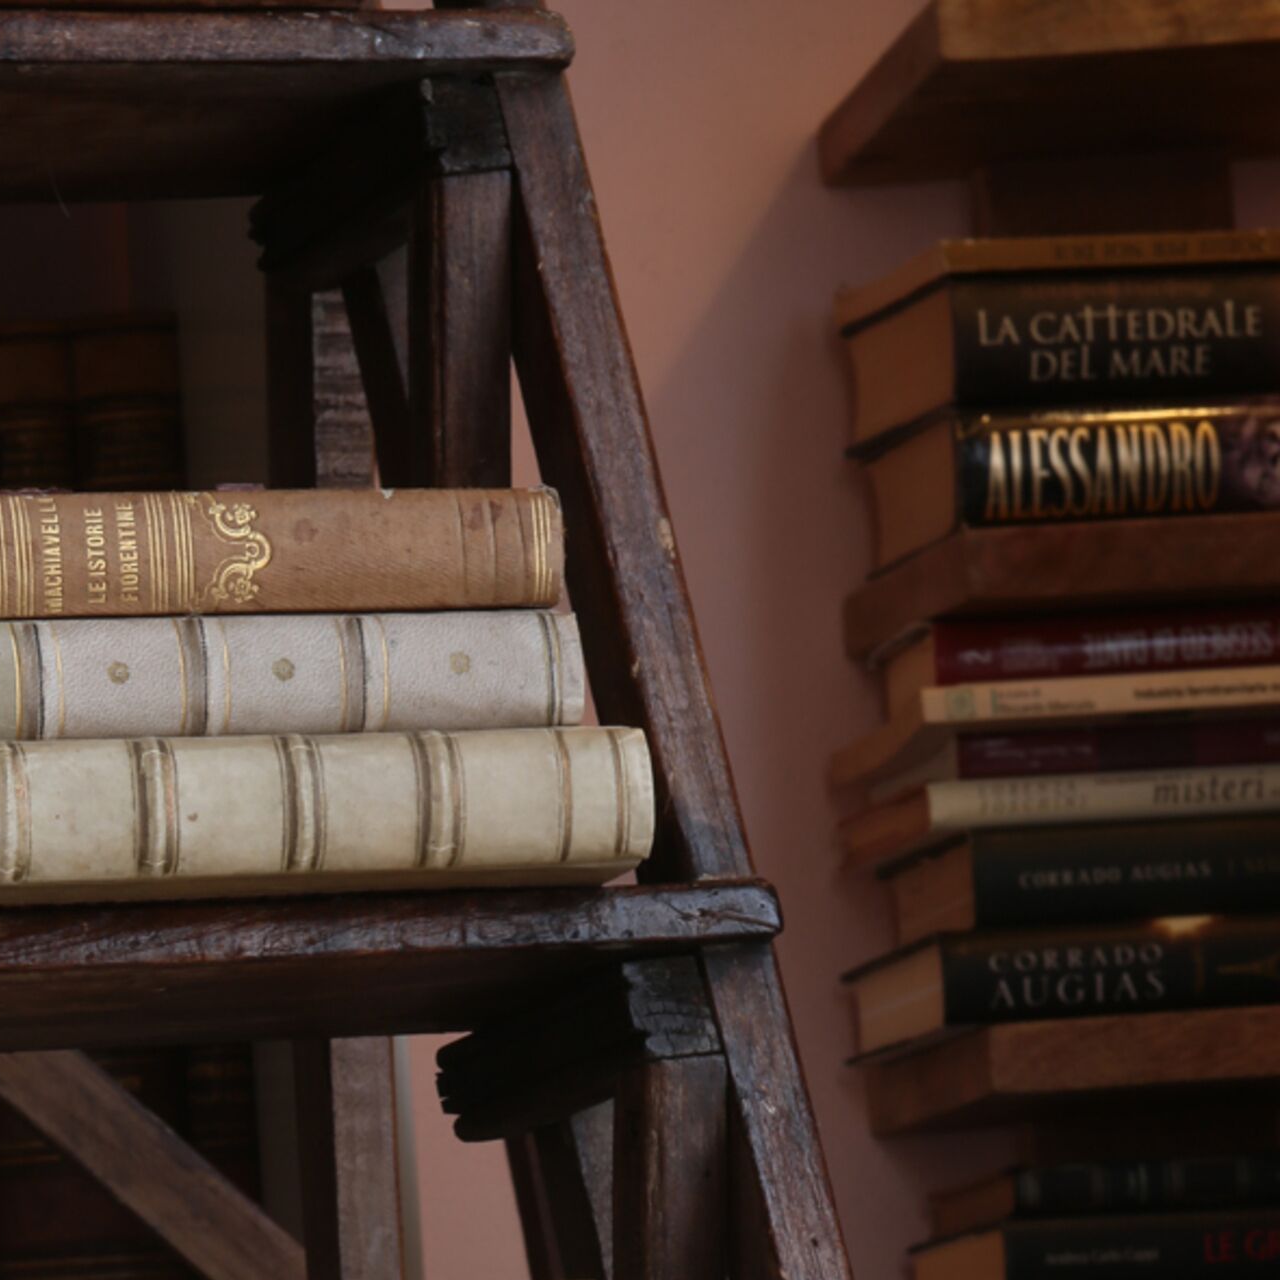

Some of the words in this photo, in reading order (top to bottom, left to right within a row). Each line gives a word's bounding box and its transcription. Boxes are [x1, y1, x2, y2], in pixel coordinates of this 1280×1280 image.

[978, 309, 1019, 347] LA
[1029, 300, 1263, 345] CATTEDRALE
[1029, 342, 1096, 383] DEL
[1109, 343, 1212, 379] MARE
[985, 420, 1222, 521] ALESSANDRO
[83, 507, 107, 577] ISTORIE
[115, 501, 139, 602] FIORENTINE
[87, 581, 108, 604] LE
[1017, 865, 1122, 891] CORRADO
[1129, 859, 1213, 883] AUGIAS
[987, 941, 1165, 974] CORRADO
[990, 968, 1168, 1011] AUGIAS
[1202, 1232, 1235, 1264] LE
